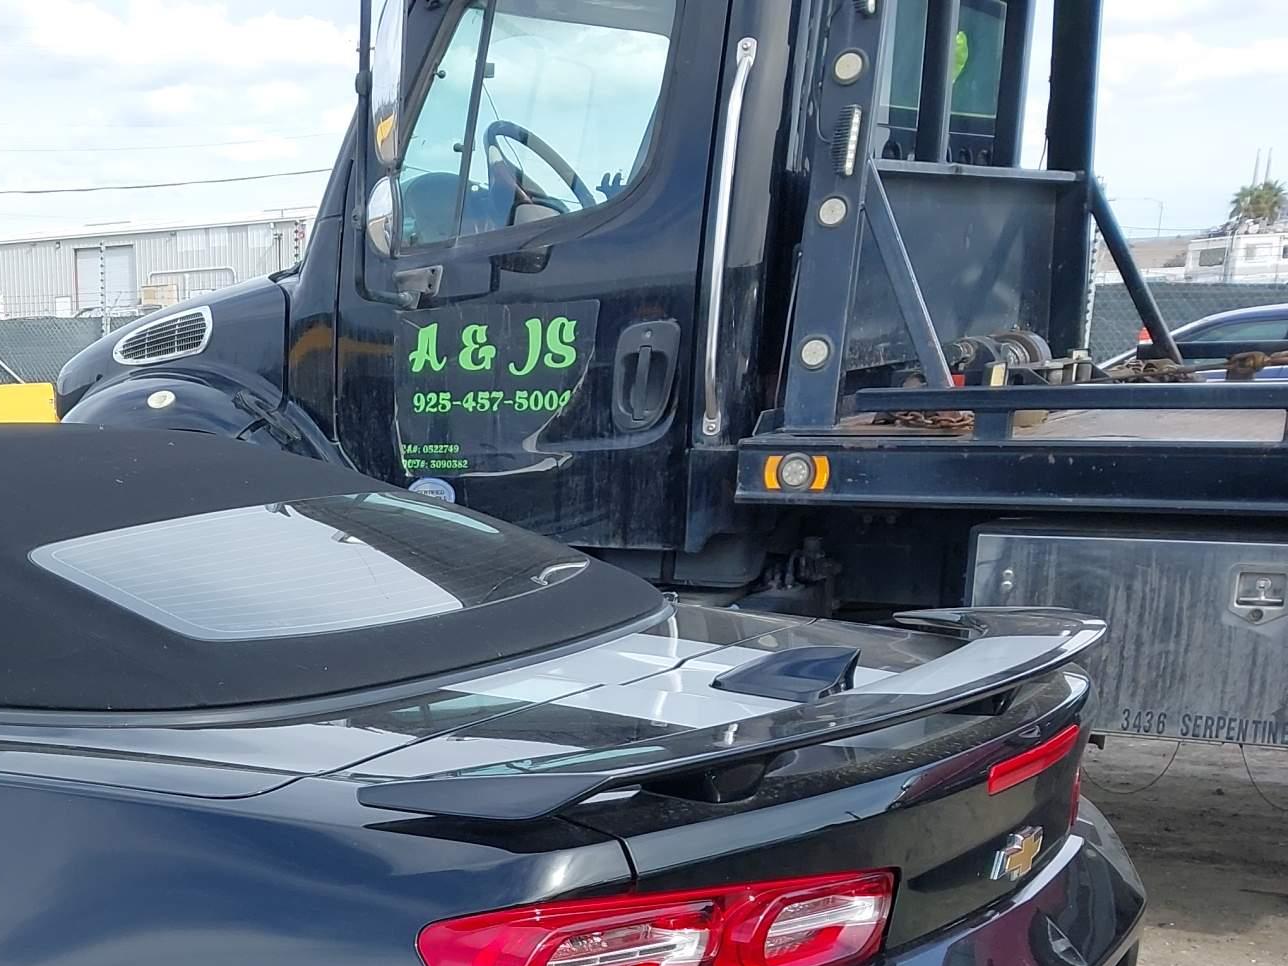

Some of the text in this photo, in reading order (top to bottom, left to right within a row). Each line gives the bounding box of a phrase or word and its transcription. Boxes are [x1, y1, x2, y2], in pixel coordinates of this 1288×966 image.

[408, 317, 577, 376] A & JS
[1121, 708, 1167, 734] 3436
